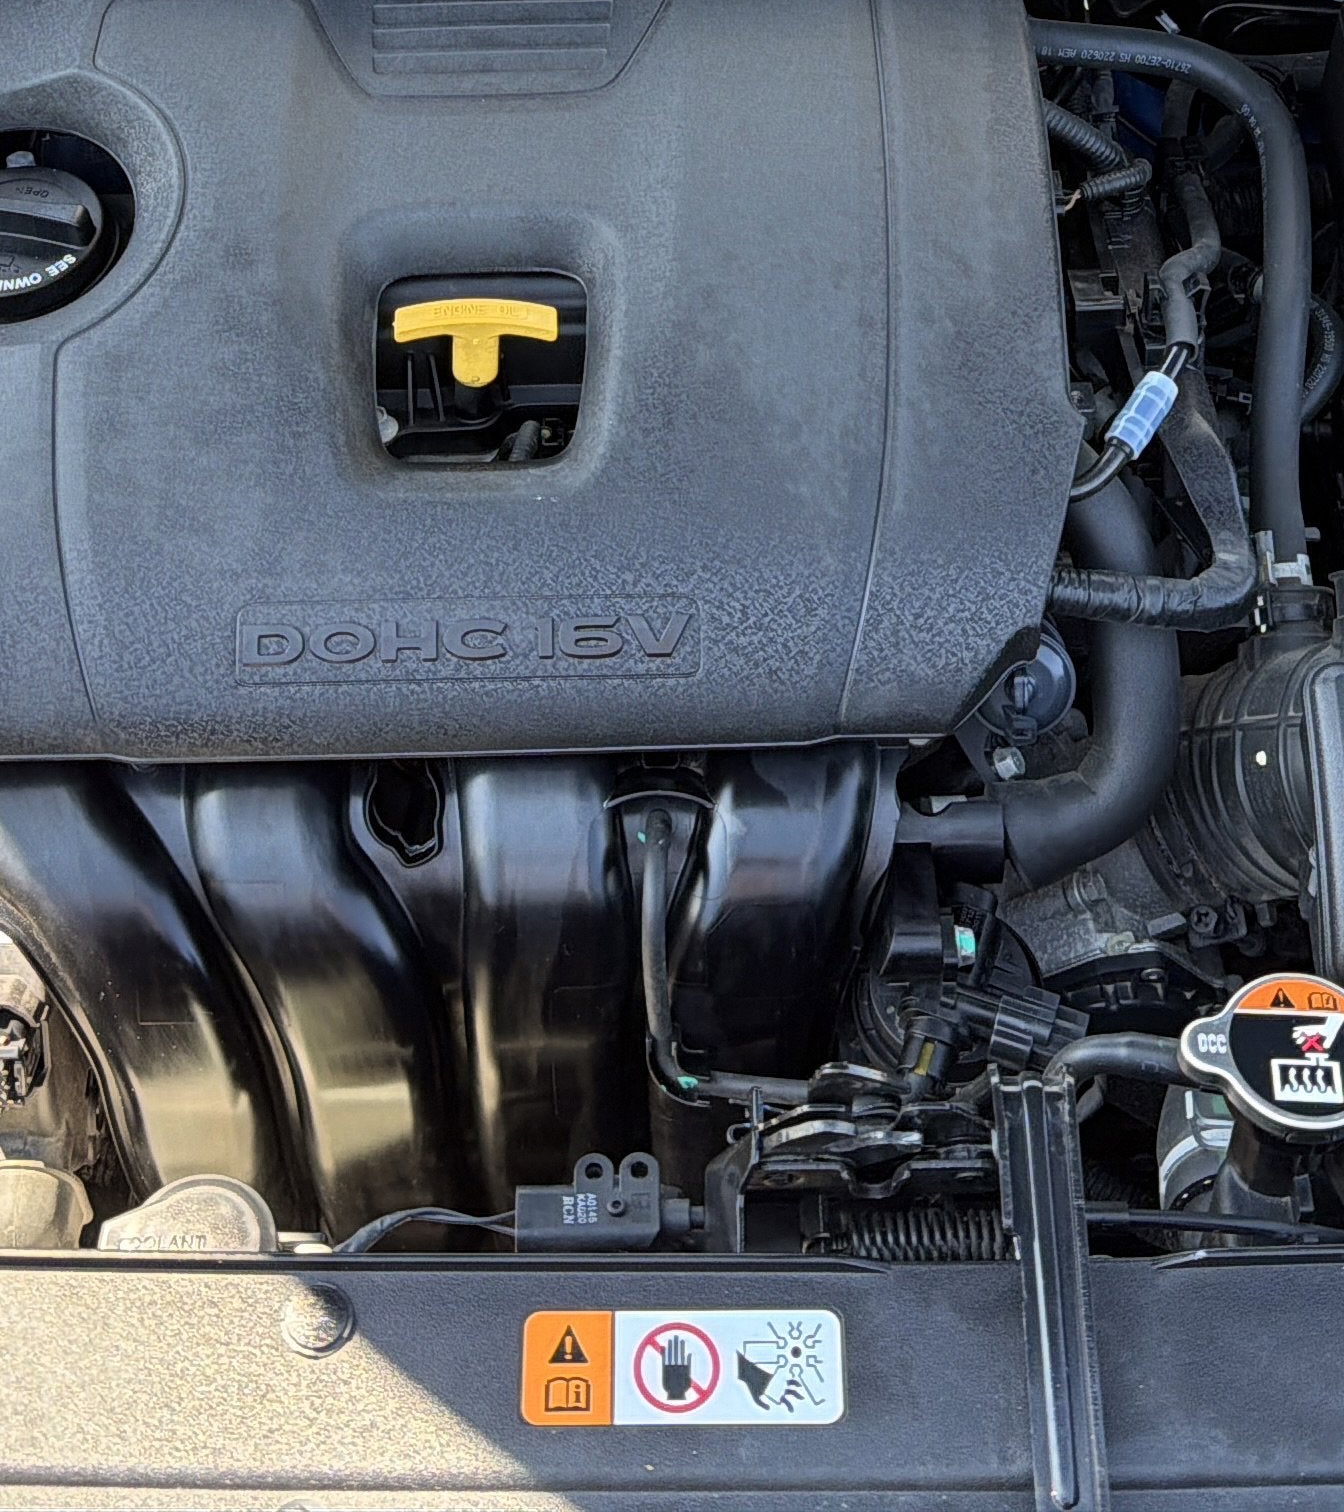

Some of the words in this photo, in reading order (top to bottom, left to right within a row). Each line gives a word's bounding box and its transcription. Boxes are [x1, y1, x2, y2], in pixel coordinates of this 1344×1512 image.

[45, 254, 77, 277] SEE
[241, 618, 508, 667] DOHC
[536, 613, 693, 661] 16V
